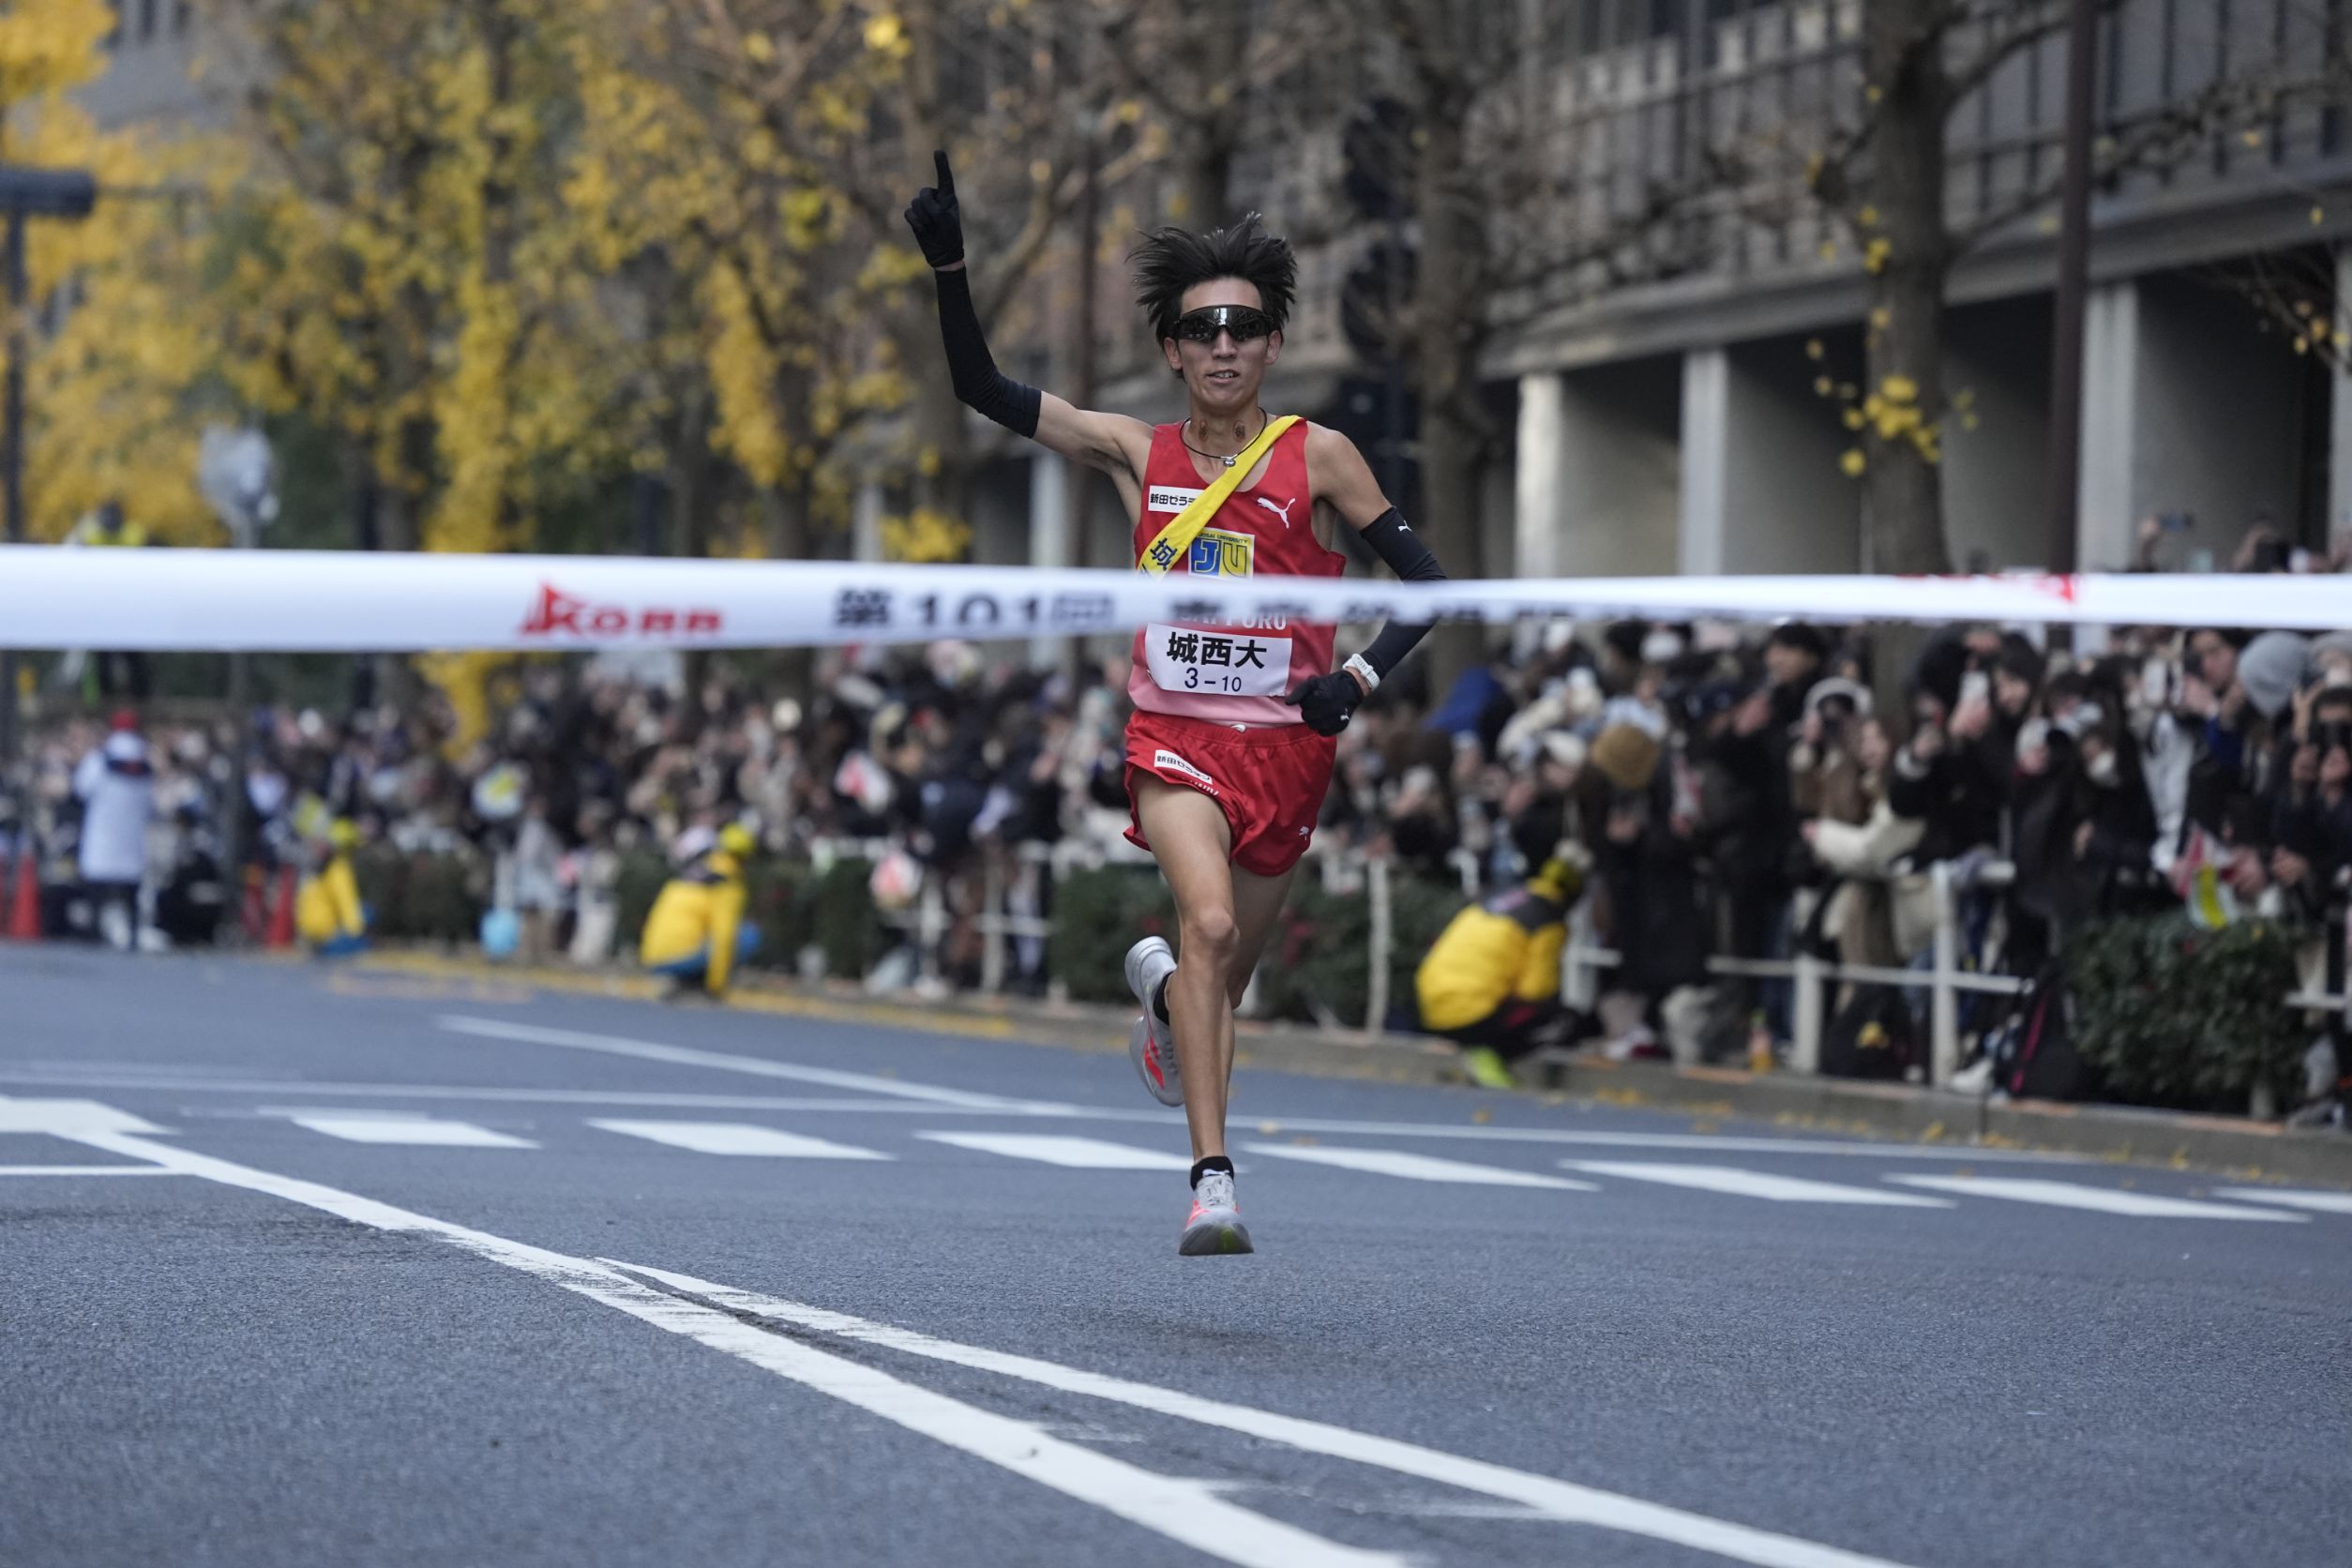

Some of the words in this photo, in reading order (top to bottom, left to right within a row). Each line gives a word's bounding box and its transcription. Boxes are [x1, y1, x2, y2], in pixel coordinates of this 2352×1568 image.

[1194, 539, 1247, 578] JU
[1167, 631, 1267, 669] 城西大
[1184, 667, 1242, 692] 3-10
